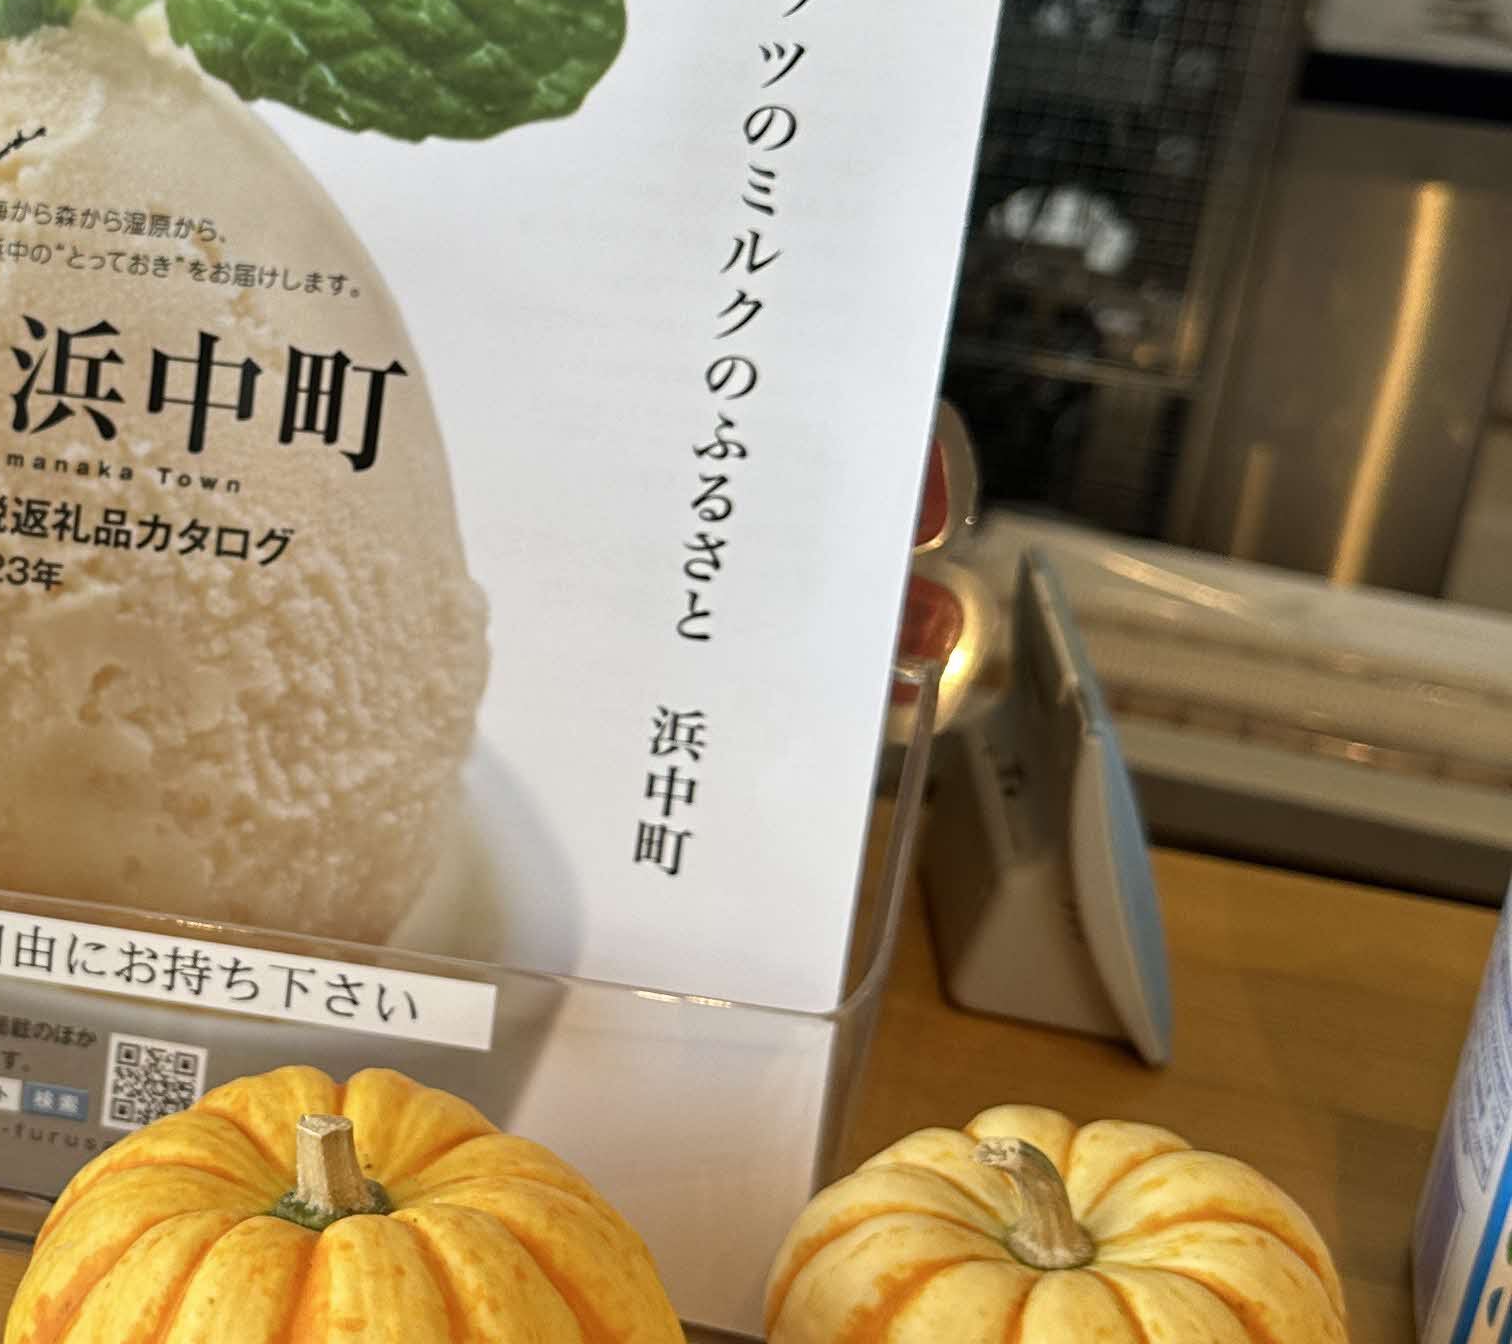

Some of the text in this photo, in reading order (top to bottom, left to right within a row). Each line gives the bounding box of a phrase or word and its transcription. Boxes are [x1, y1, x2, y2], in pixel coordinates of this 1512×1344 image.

[10, 313, 408, 473] 浜中町
[158, 467, 243, 495] Town
[633, 705, 707, 877] 浜中町
